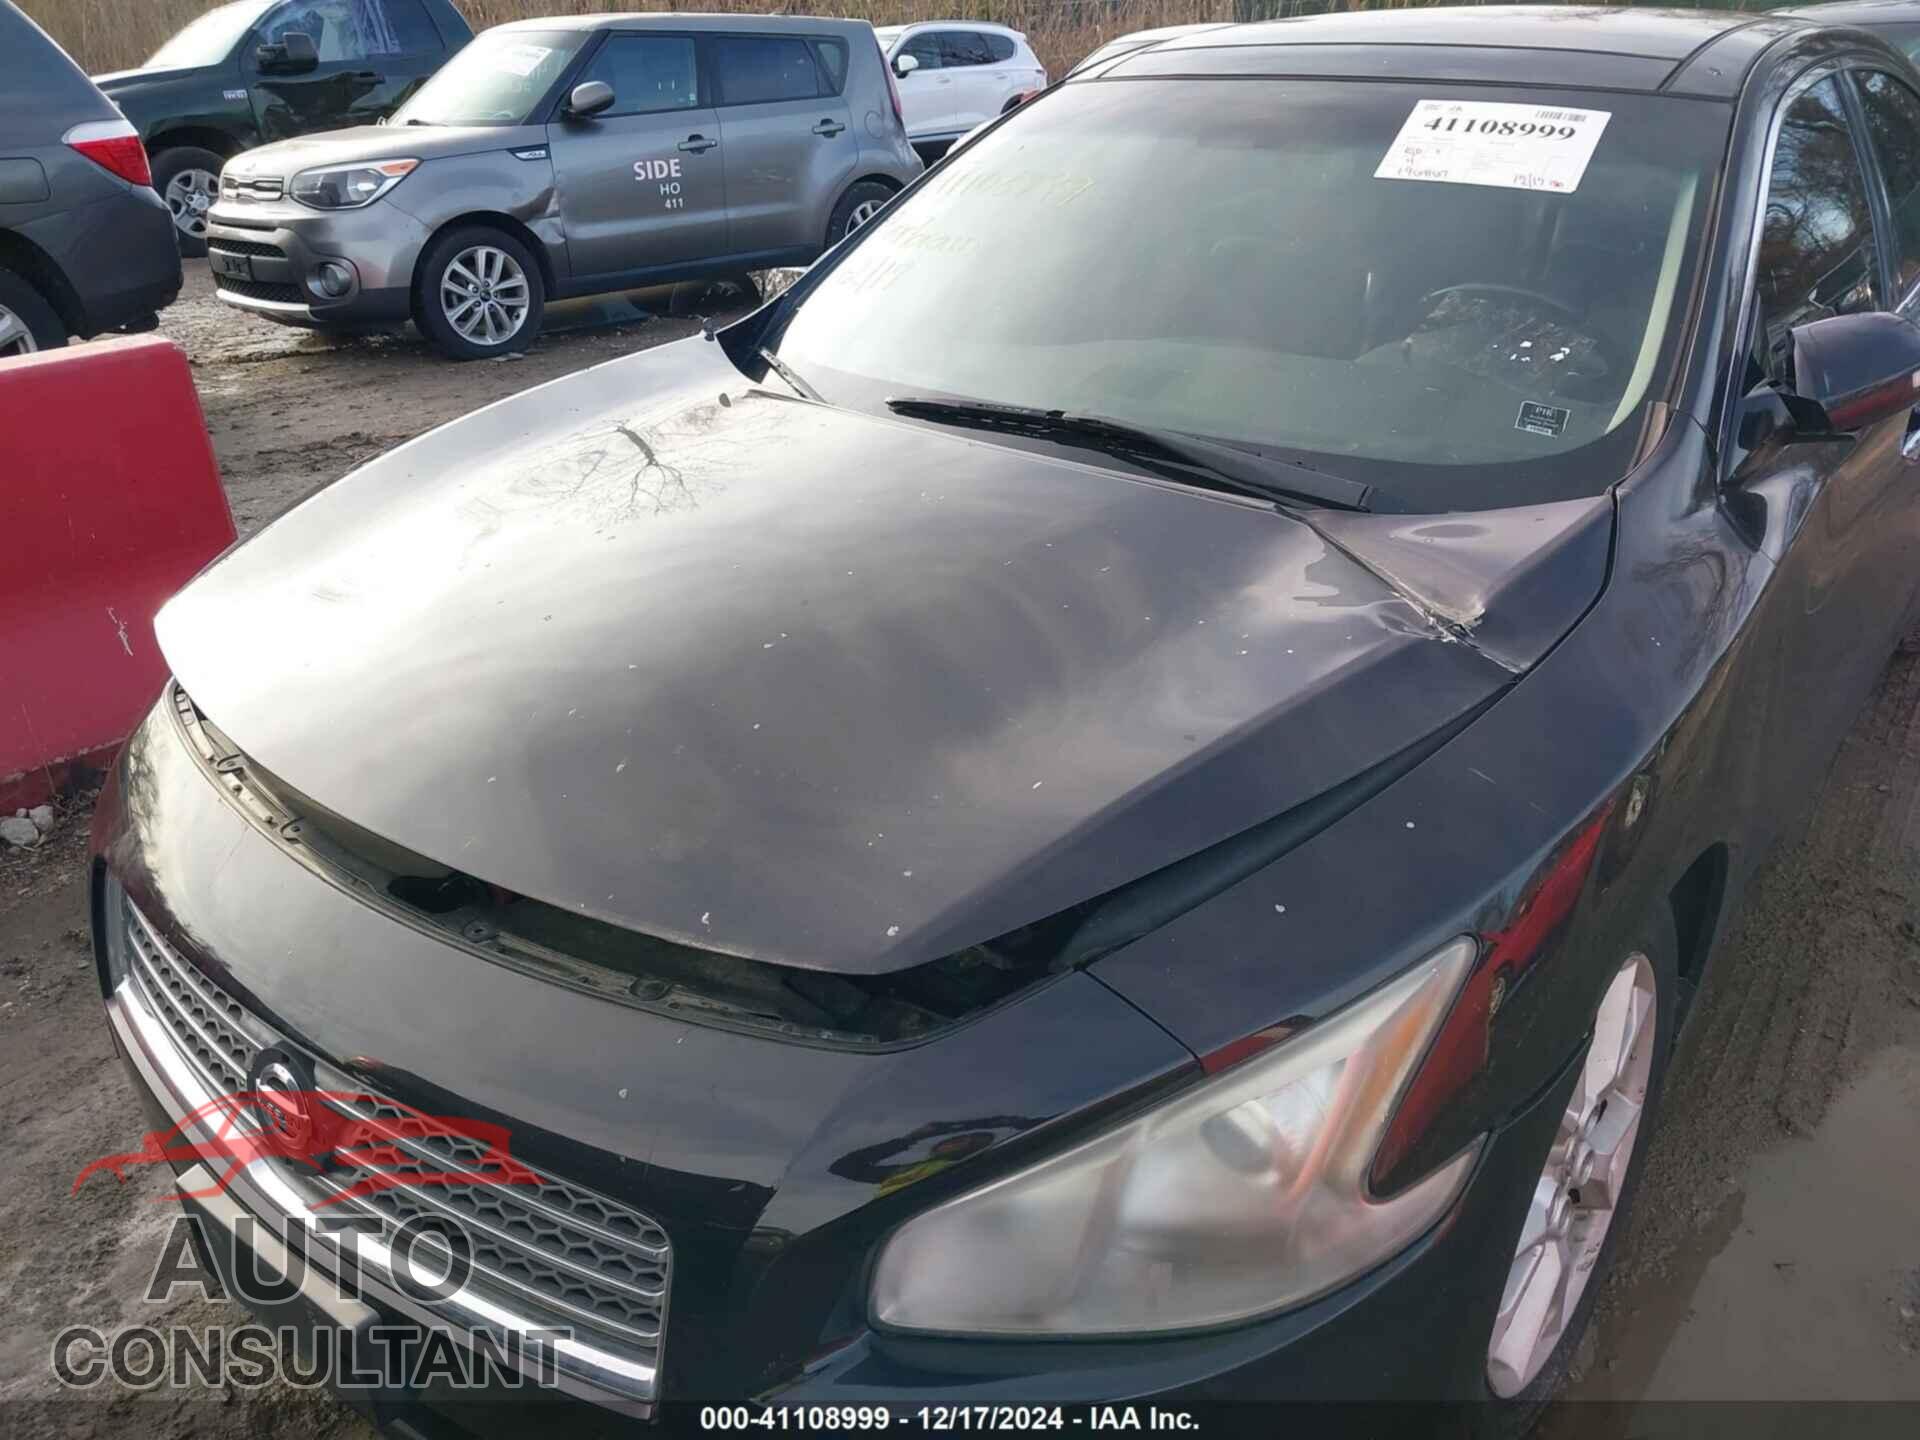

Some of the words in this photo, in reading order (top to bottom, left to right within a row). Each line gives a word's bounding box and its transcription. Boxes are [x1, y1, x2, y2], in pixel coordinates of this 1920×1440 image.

[1425, 117, 1576, 140] 41108999
[634, 159, 682, 181] SIDE
[661, 183, 681, 195] HO
[665, 198, 683, 209] 411
